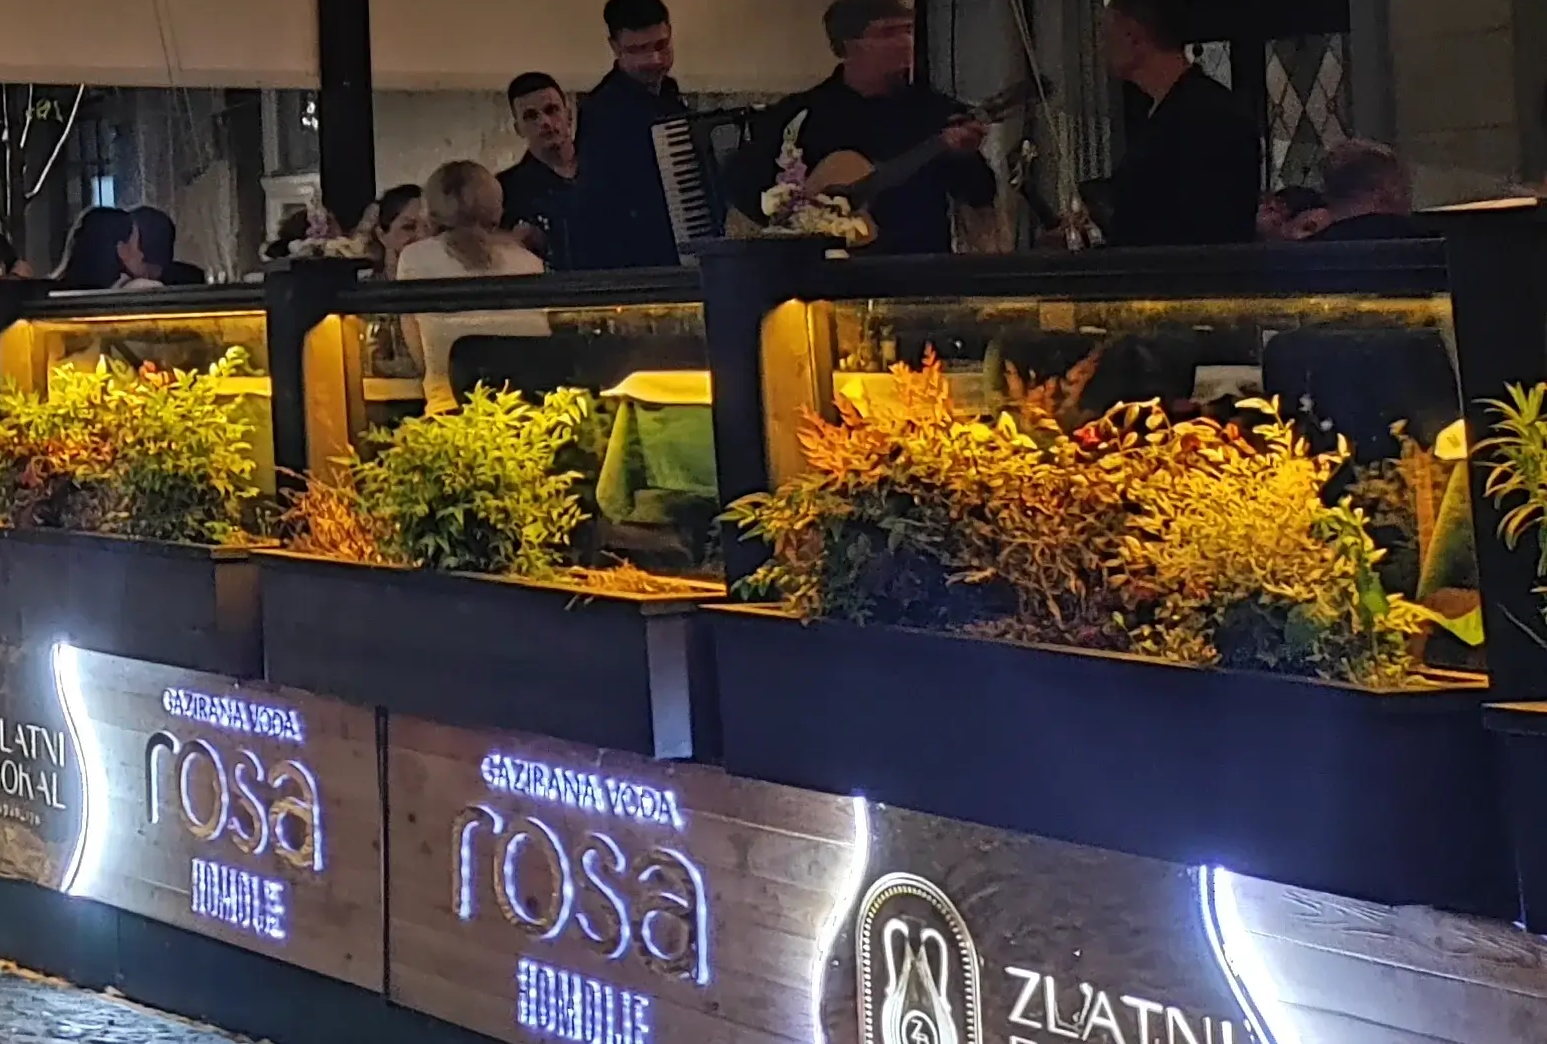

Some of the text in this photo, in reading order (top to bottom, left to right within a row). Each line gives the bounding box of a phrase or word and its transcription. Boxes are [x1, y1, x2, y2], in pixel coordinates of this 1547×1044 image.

[145, 730, 324, 872] rosa
[480, 752, 685, 831] GAZIRANA VODA
[452, 804, 710, 986] rosa
